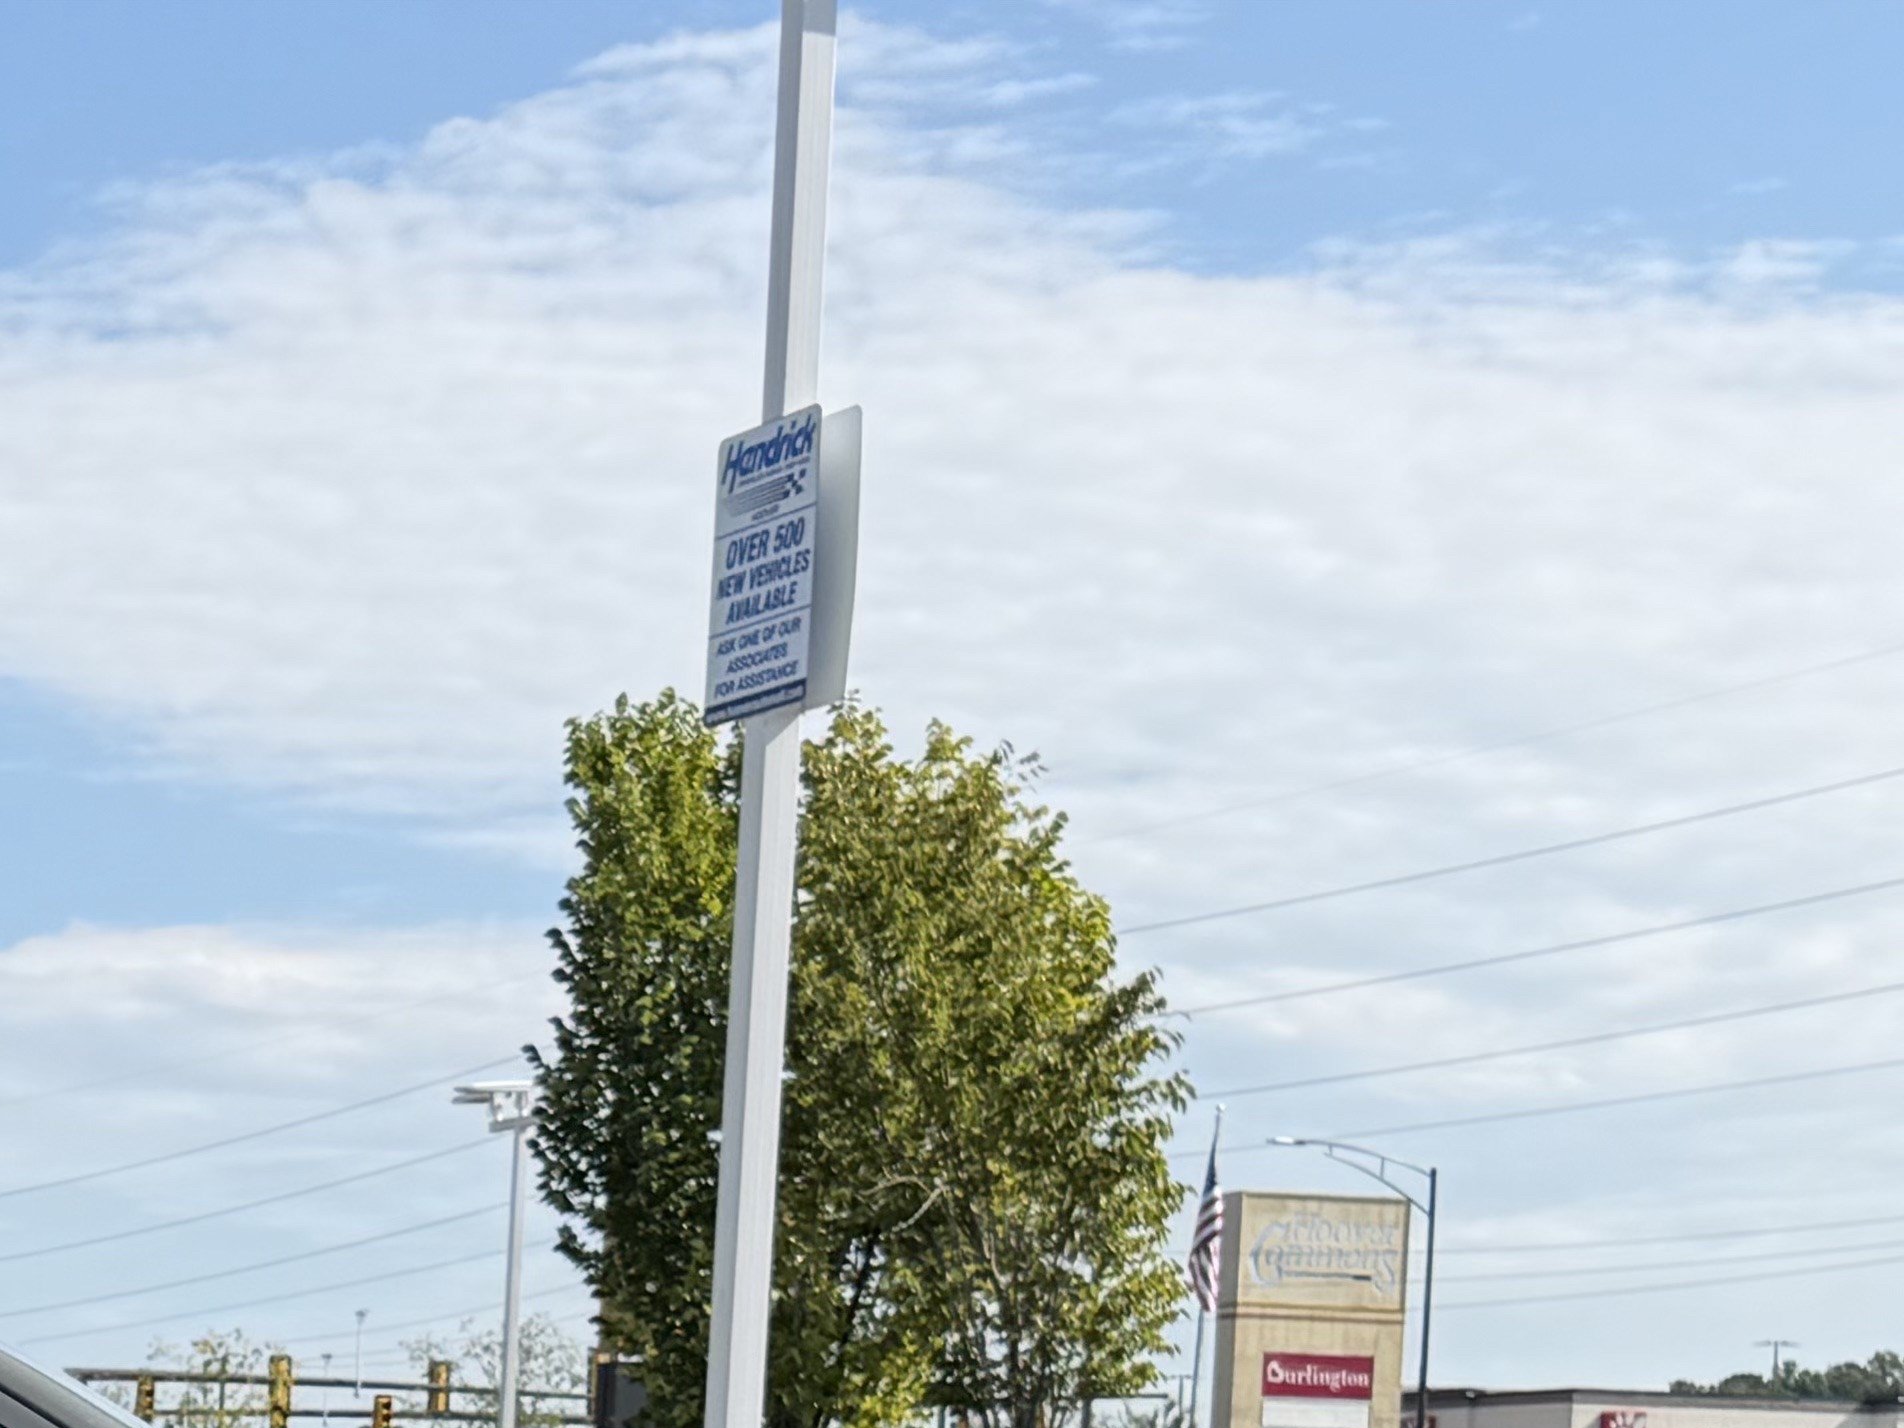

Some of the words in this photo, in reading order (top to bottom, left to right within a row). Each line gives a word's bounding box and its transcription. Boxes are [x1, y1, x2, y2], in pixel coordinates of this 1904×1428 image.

[721, 414, 817, 494] Hendrick
[726, 530, 767, 569] OVER
[773, 516, 805, 552] 500
[716, 572, 744, 600] NEW
[749, 549, 810, 589] VEHICLES
[725, 582, 797, 625] AVAILABLE
[1266, 1360, 1370, 1393] Burlington
